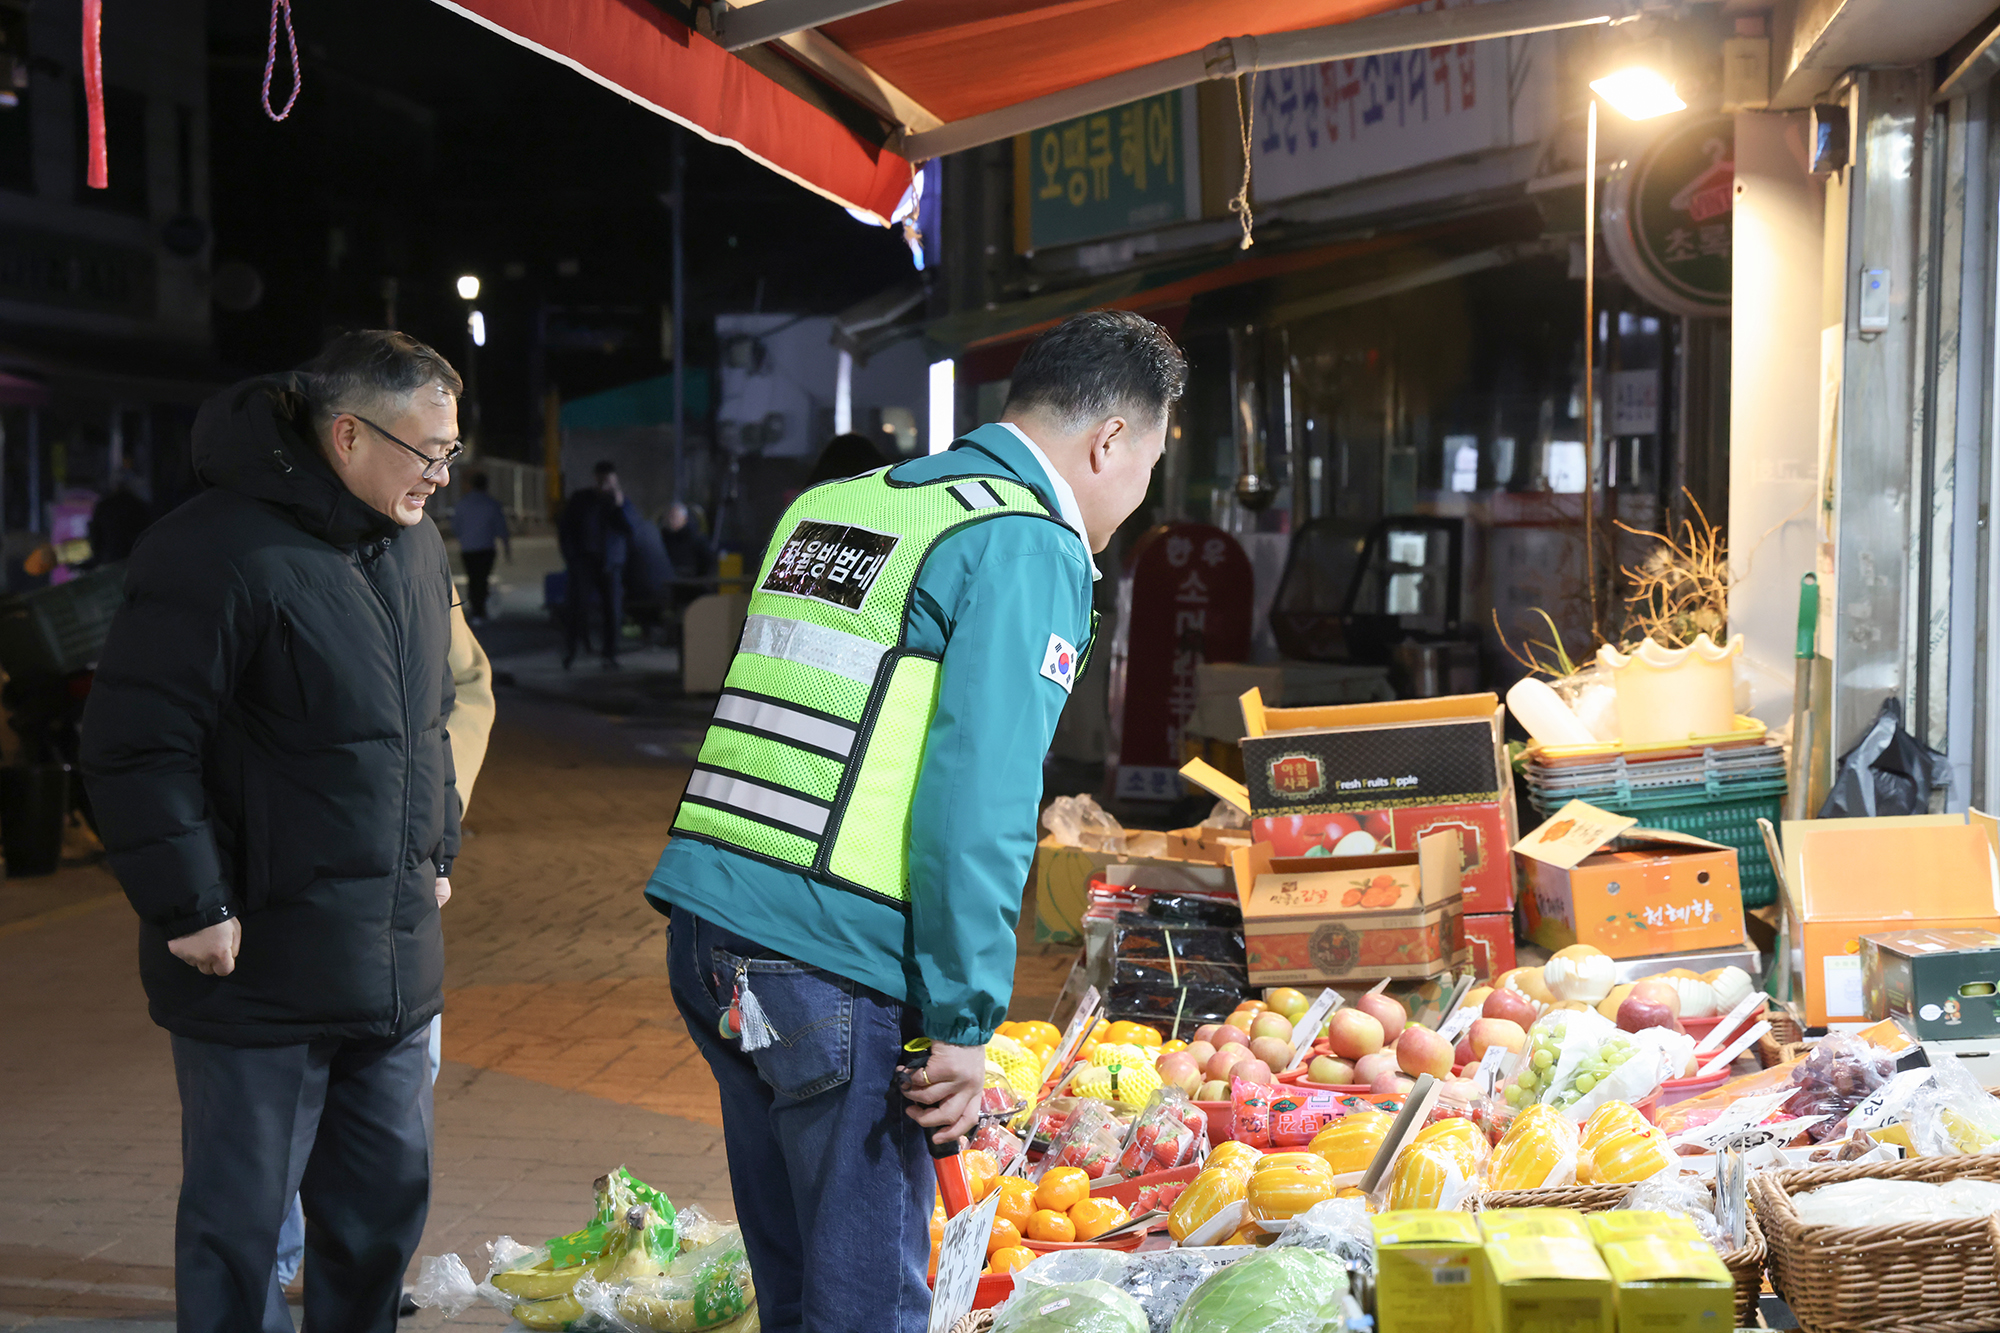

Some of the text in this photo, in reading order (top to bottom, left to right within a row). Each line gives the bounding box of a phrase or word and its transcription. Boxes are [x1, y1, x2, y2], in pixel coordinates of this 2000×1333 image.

[1166, 535, 1227, 568] 한우
[1281, 762, 1308, 776] 아침
[1283, 776, 1310, 790] 사과
[1335, 775, 1419, 790] Fresh Fruits Apple
[1642, 898, 1715, 927] 천혜향
[1277, 1112, 1320, 1135] 단감
